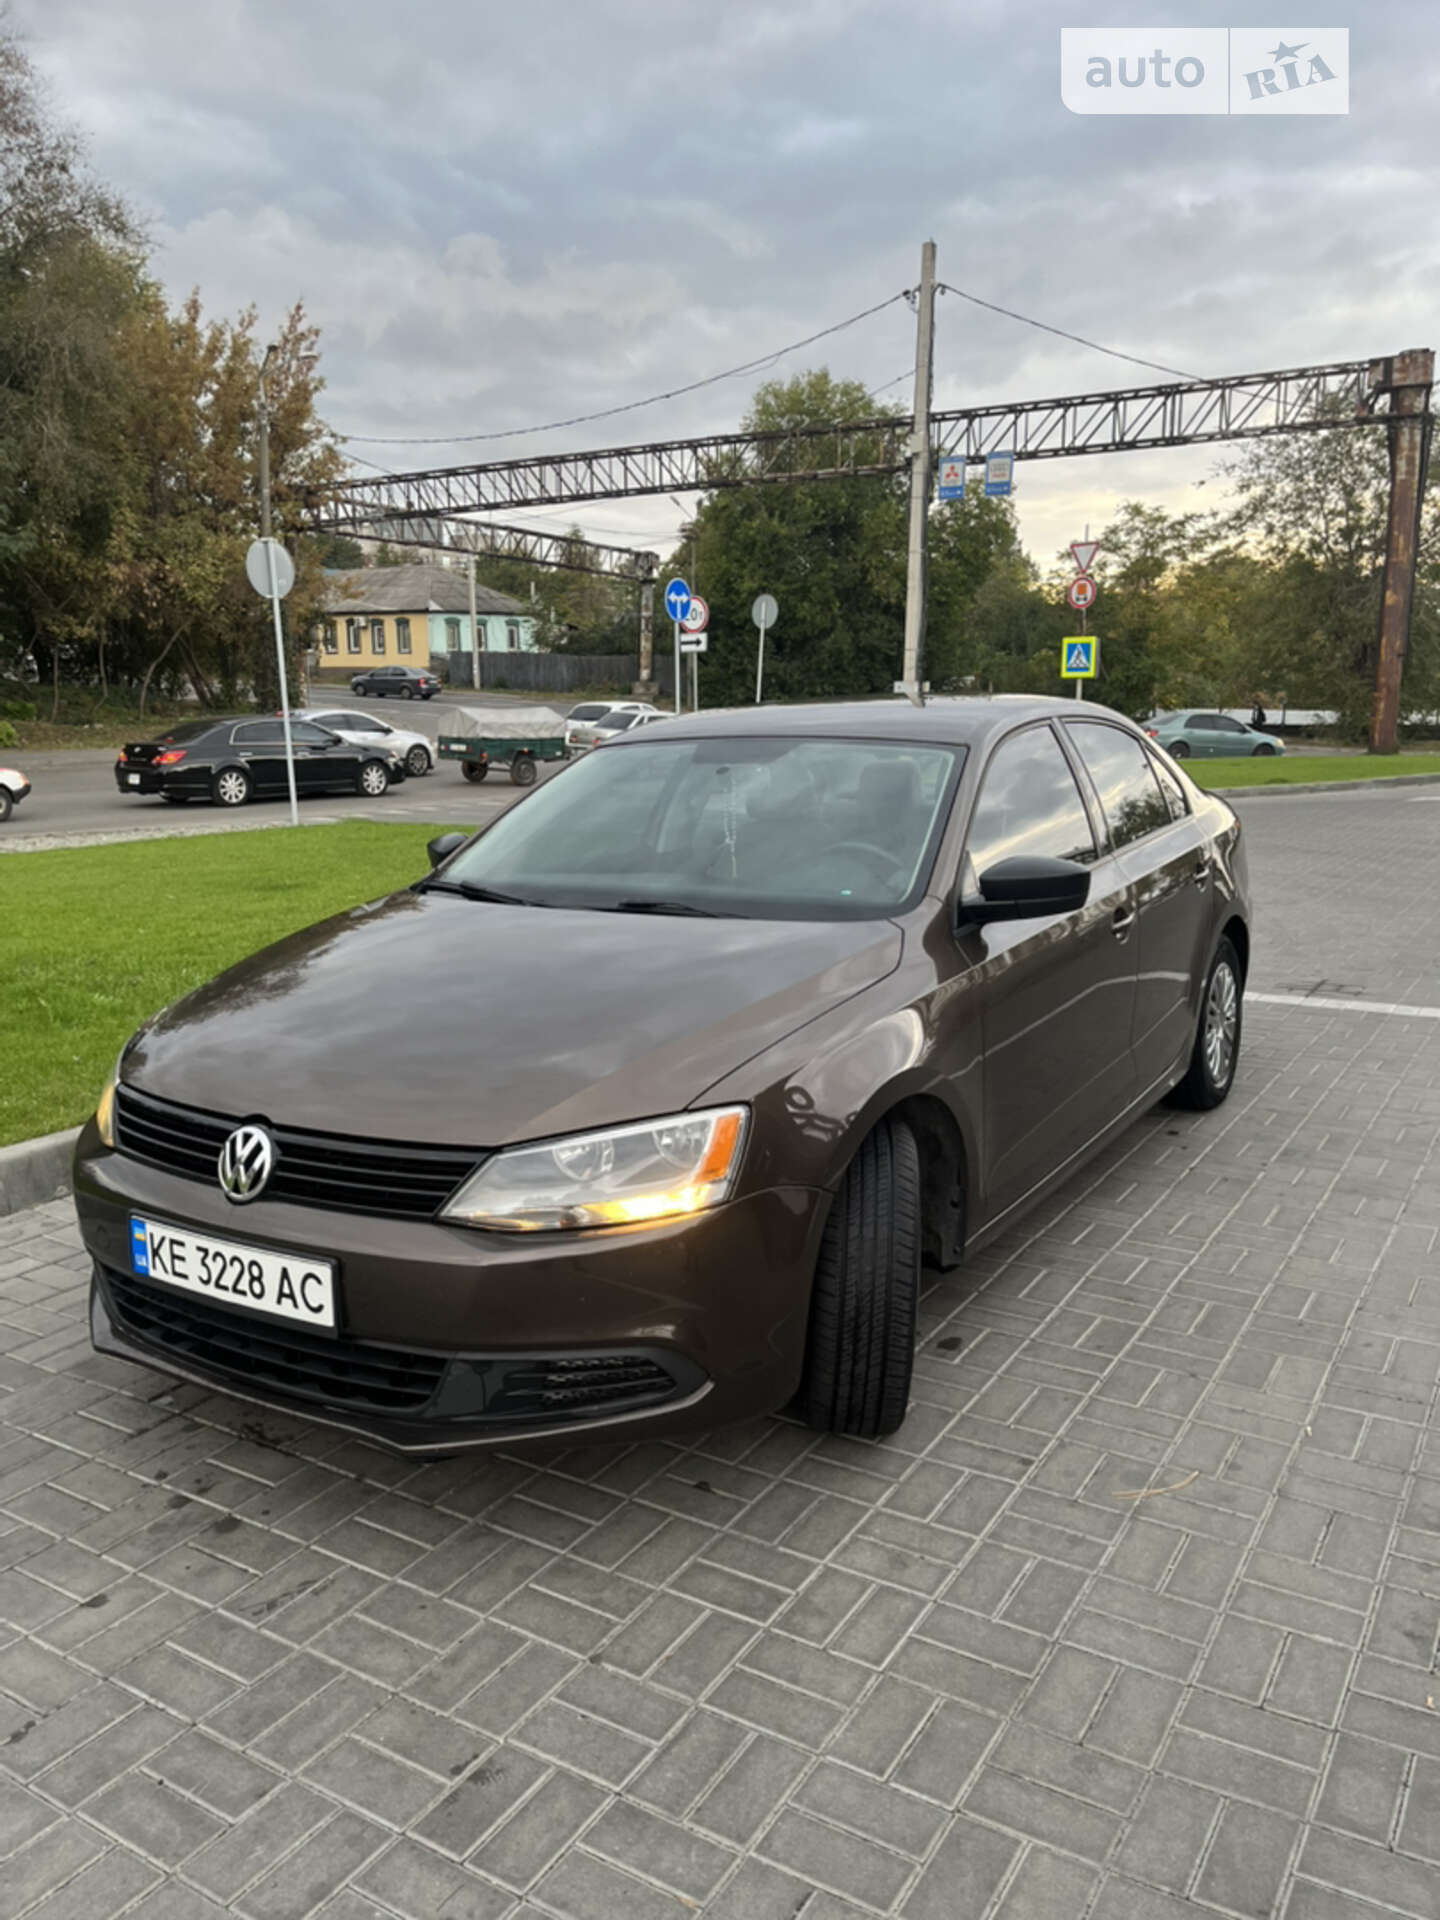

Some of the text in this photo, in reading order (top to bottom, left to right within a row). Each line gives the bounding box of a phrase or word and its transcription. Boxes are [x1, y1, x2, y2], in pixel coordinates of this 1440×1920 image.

[149, 1231, 325, 1315] KE 3228 AC
